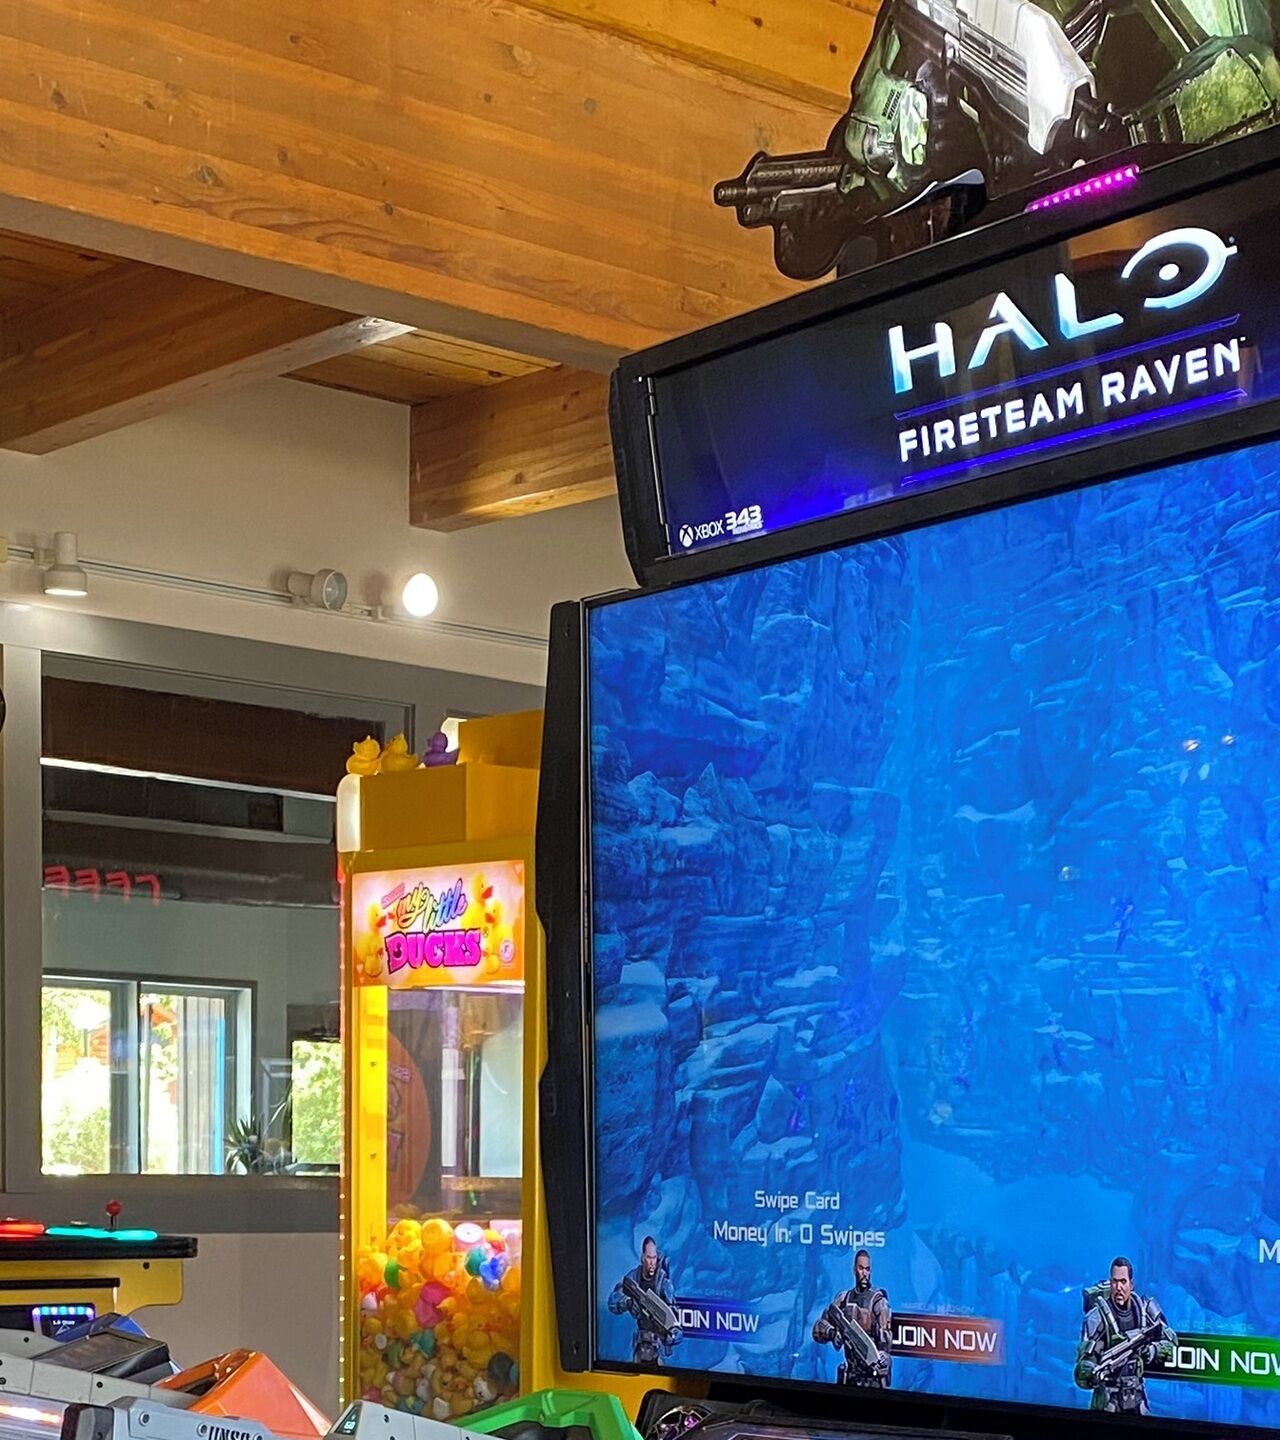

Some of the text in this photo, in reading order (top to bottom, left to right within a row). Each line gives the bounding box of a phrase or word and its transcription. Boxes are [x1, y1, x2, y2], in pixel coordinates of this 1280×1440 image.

[887, 226, 1240, 395] HALO
[897, 339, 1242, 464] FIRETEAM RAVEN
[694, 519, 725, 541] XBOX
[725, 504, 763, 531] 343
[384, 928, 482, 975] DUCKS
[754, 1190, 841, 1212] Swipe Card
[713, 1220, 768, 1247] Money
[774, 1223, 792, 1244] In:
[820, 1224, 886, 1251] Swipes
[674, 1308, 760, 1333] JOIN NOW
[891, 1325, 998, 1354] JOIN NOW
[1164, 1346, 1220, 1371] JOIN
